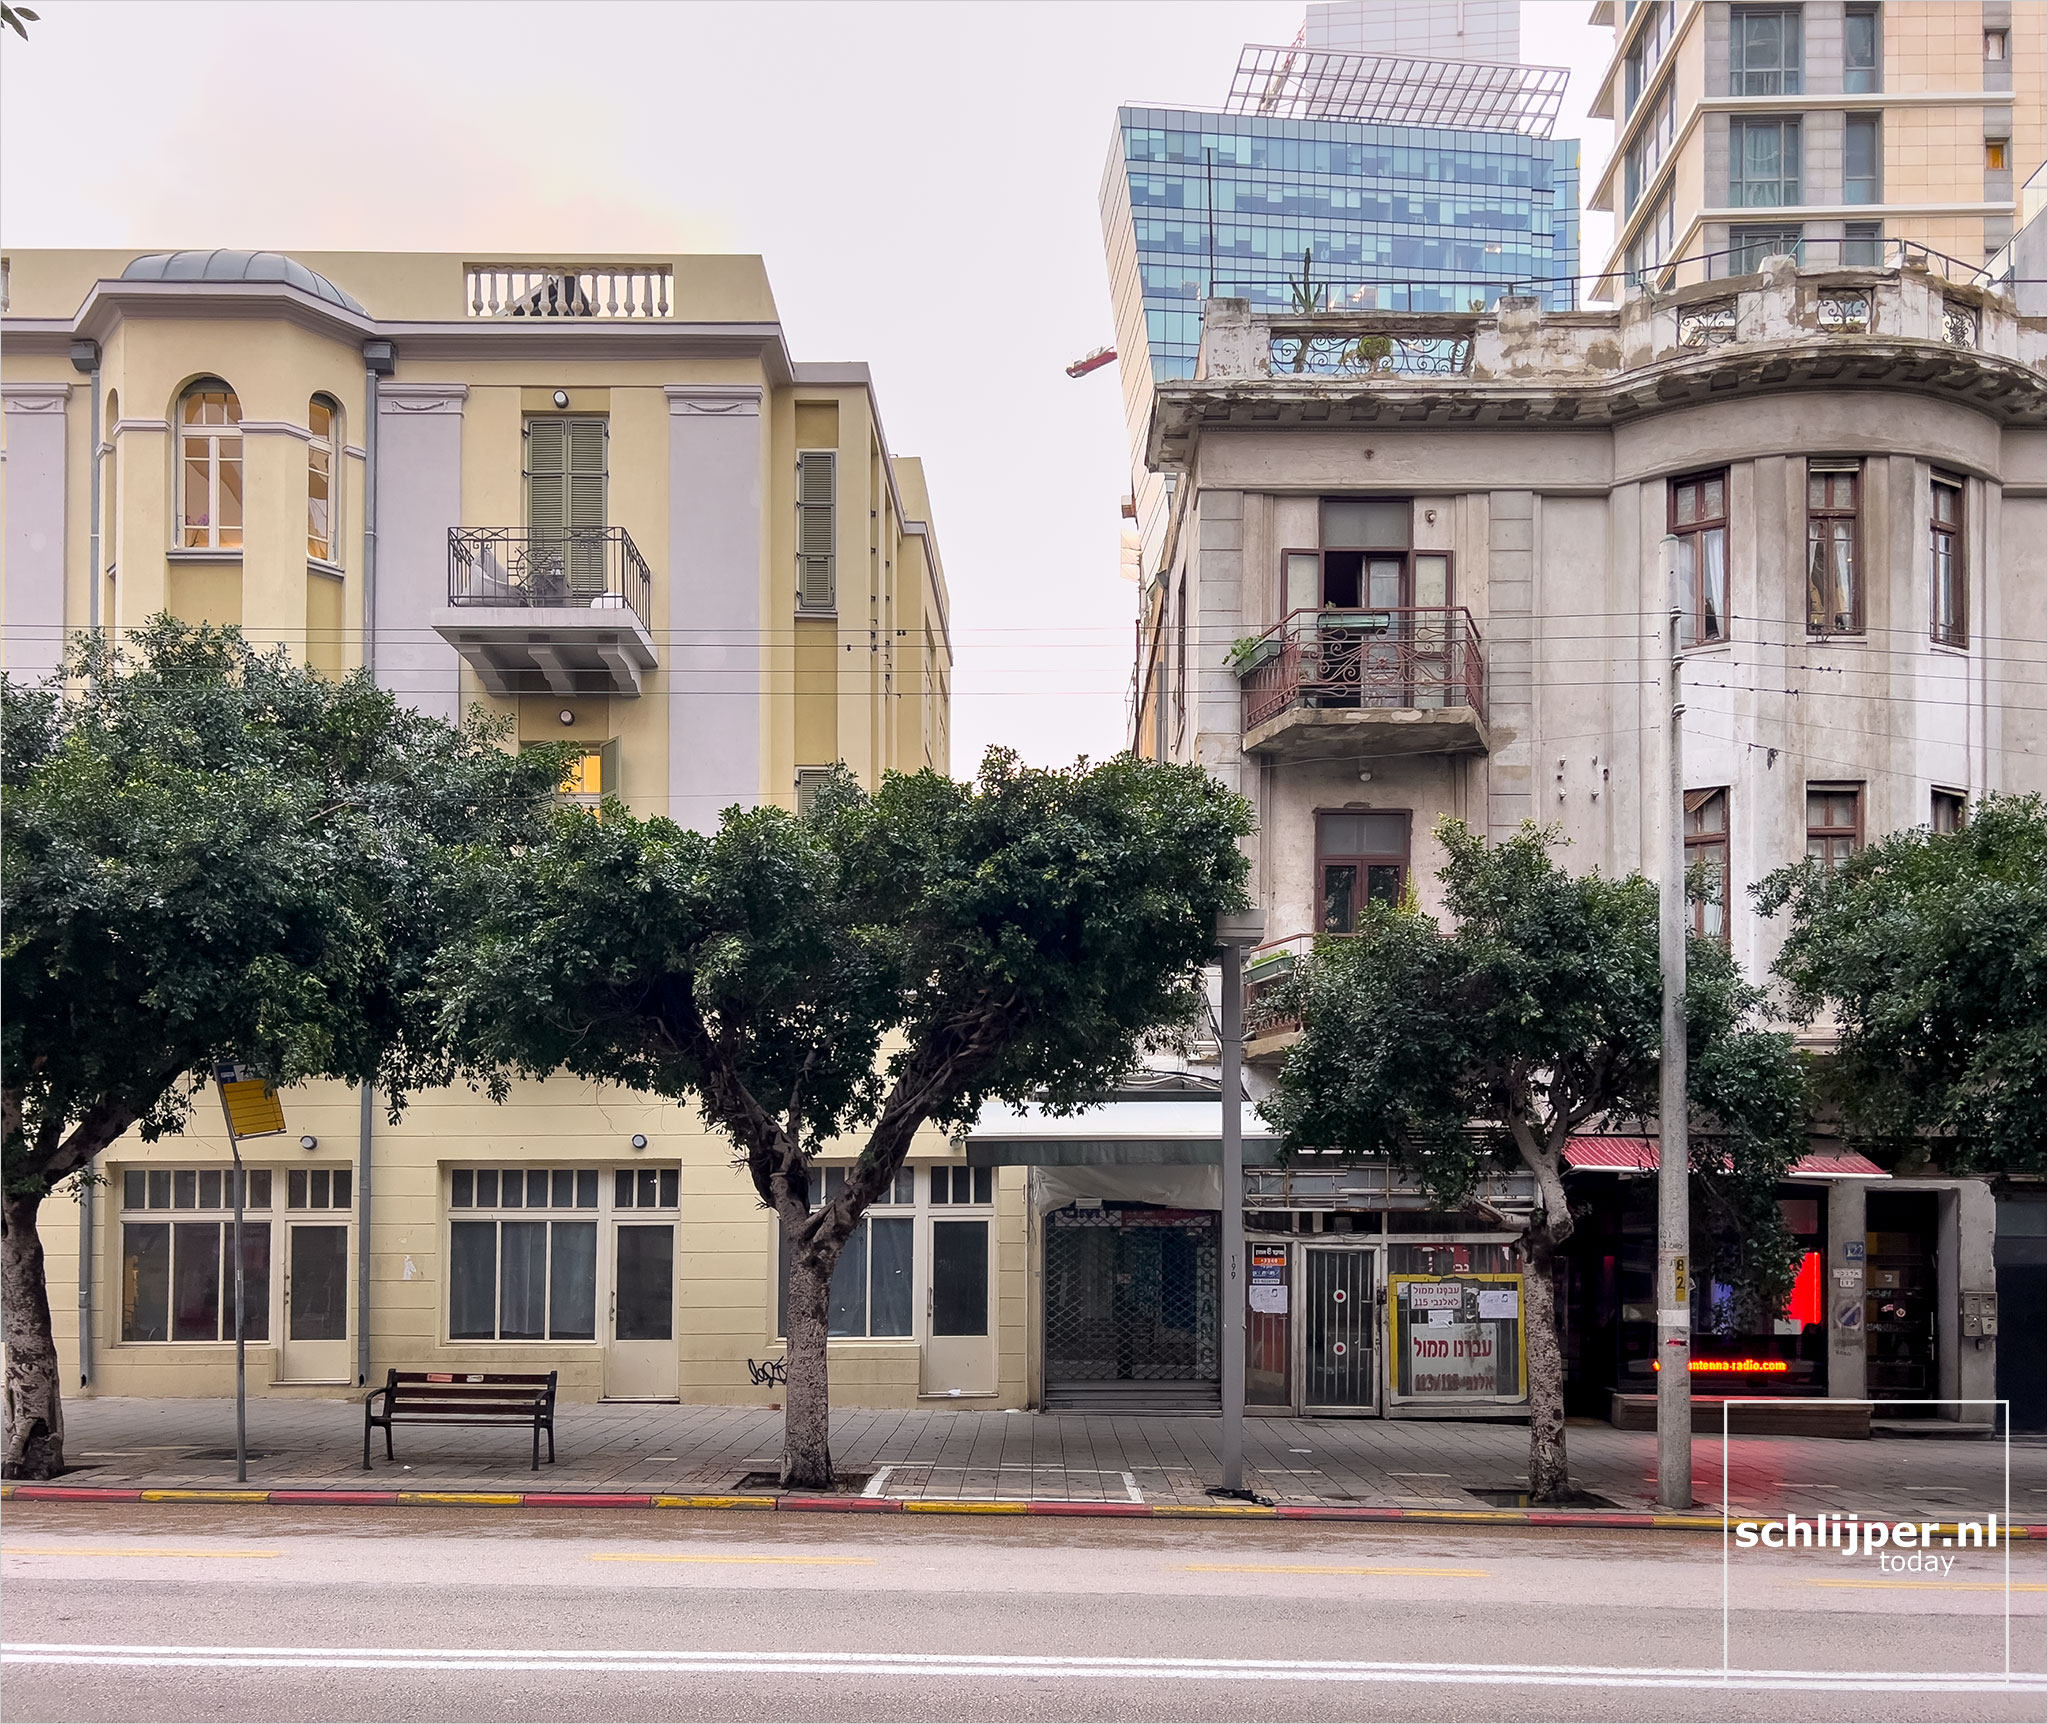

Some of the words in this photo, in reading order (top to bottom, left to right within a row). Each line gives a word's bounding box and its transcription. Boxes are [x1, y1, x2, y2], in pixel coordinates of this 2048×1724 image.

[1675, 1259, 1685, 1289] 82
[1413, 1286, 1434, 1294] ממול
[1430, 1297, 1459, 1306] לאלנבי
[1413, 1336, 1449, 1358] ממול
[1453, 1339, 1492, 1357] עברנו
[1652, 1359, 1787, 1372] ntenna-radio.com
